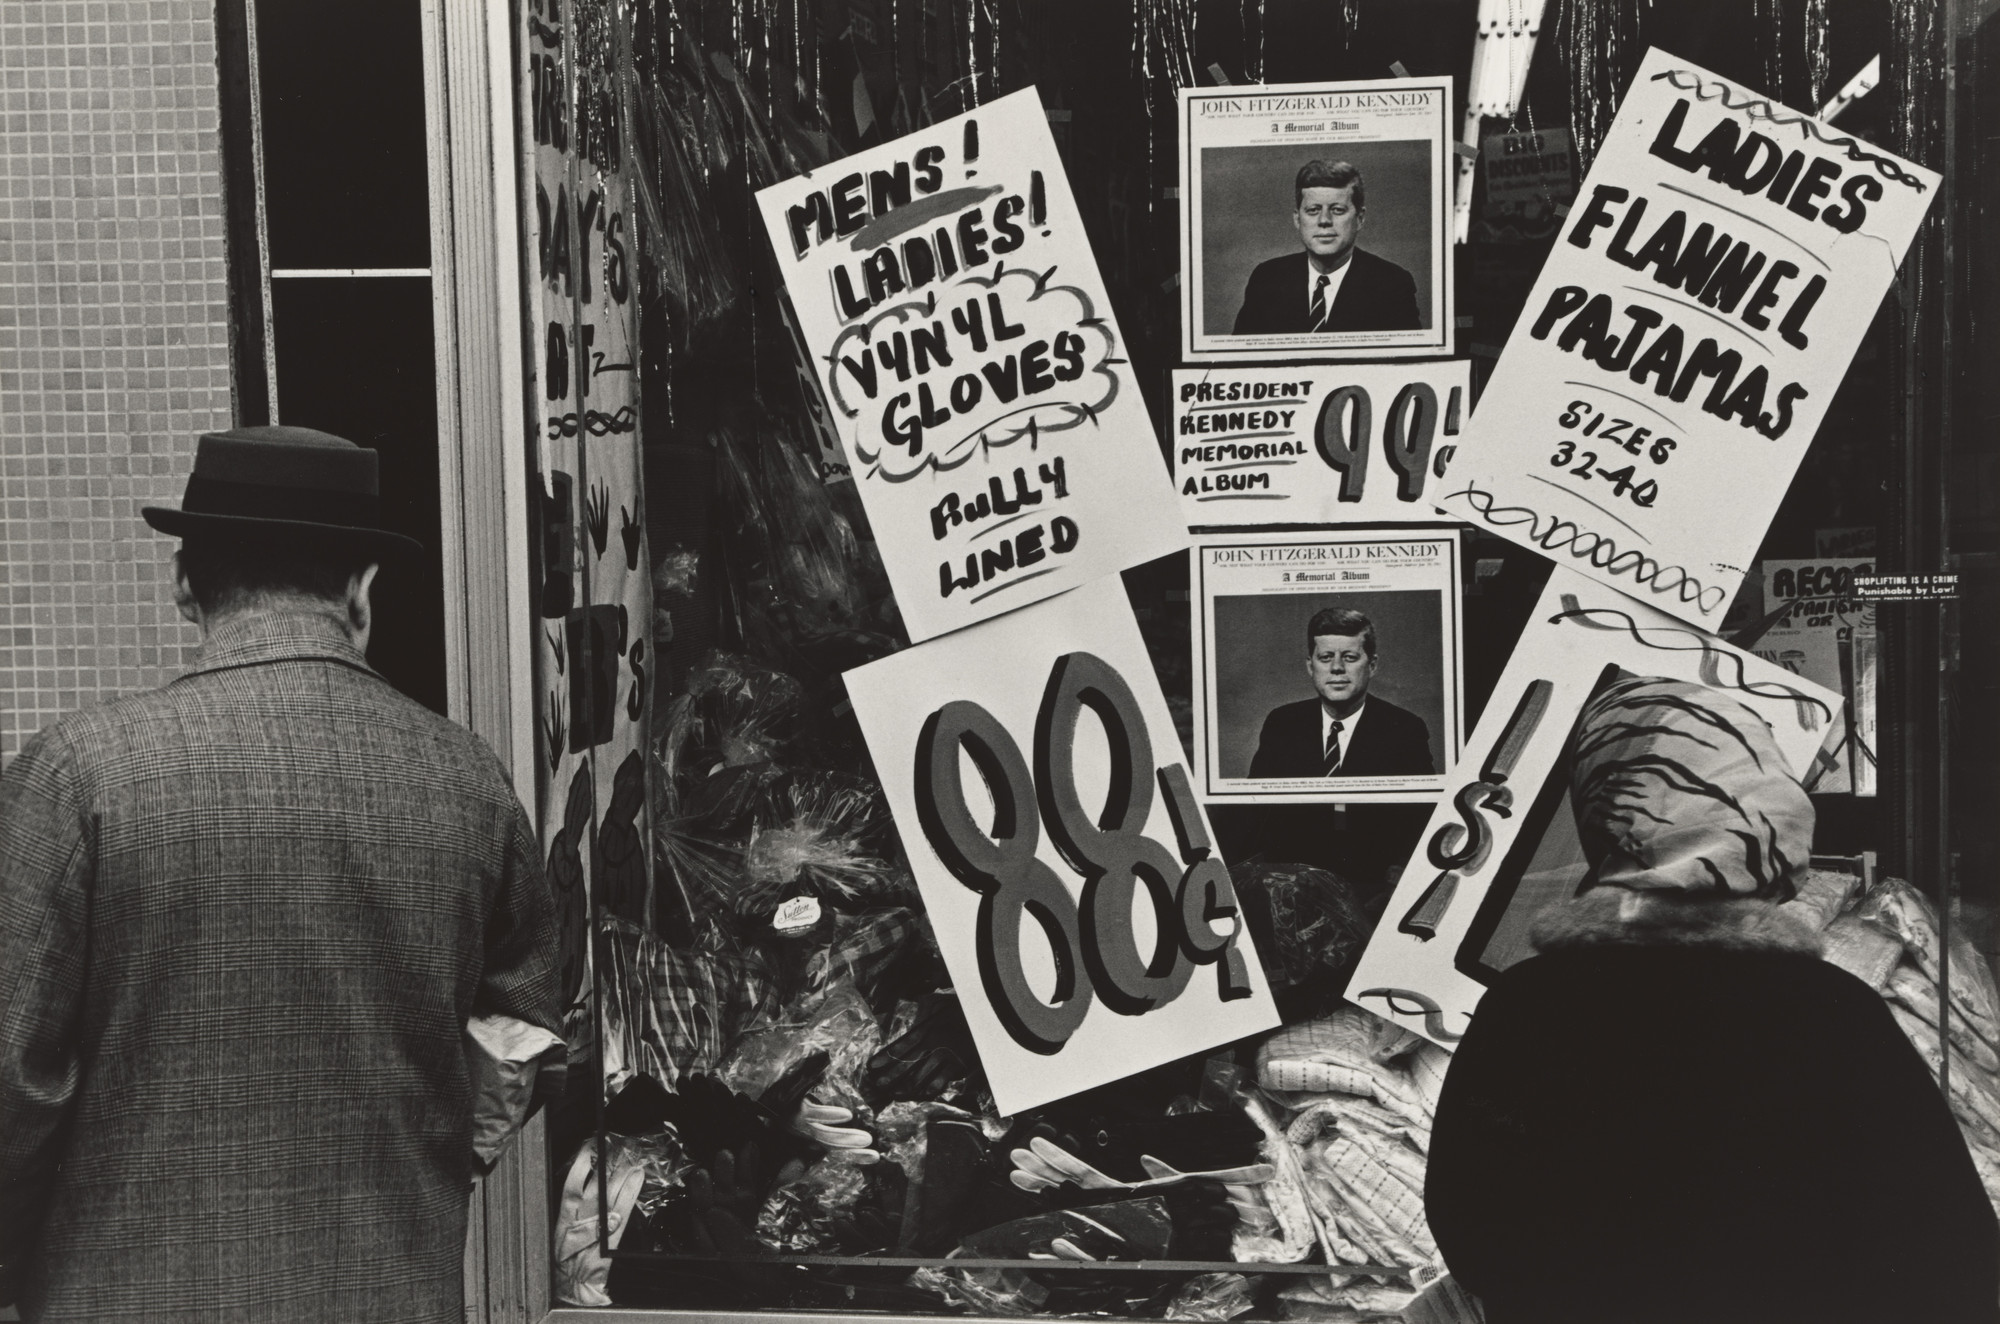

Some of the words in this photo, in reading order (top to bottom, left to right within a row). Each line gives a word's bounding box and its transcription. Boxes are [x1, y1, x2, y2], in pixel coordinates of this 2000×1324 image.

[1201, 100, 1243, 116] JOHN
[1249, 94, 1351, 112] FITZGERALD
[1356, 92, 1434, 108] KENNEDY
[1270, 123, 1279, 134] A
[1284, 122, 1325, 132] Memorial
[1331, 121, 1360, 131] Album
[1649, 98, 1884, 234] LADIES
[829, 170, 1052, 327] LADIES!
[1567, 183, 1828, 351] FLANNEL
[841, 292, 1026, 399] VYNYL
[1529, 285, 1809, 441] PAJAMAS
[881, 331, 1086, 457] GLOVES
[1180, 380, 1314, 403] PRESIDENT
[1180, 410, 1296, 435] KENNEDY
[1558, 400, 1677, 465] SIZES
[1181, 441, 1308, 465] MEMORIAL
[1182, 473, 1270, 495] ALBUM
[1550, 440, 1659, 508] 32-40
[939, 516, 1080, 598] LINED
[1212, 550, 1255, 565] JOHN
[1260, 546, 1361, 561] FITZGERALD
[1366, 544, 1443, 558] KENNEDY
[1282, 573, 1291, 583] A
[1295, 572, 1336, 582] Memorial
[1341, 571, 1370, 581] Album
[1853, 576, 1907, 586] SHOPLIFTING
[1911, 576, 1920, 584] IS
[1923, 576, 1929, 584] A
[1932, 575, 1959, 584] CRIME
[1857, 586, 1912, 596] Punishable
[1915, 586, 1928, 595] by
[1932, 585, 1955, 594] Law!
